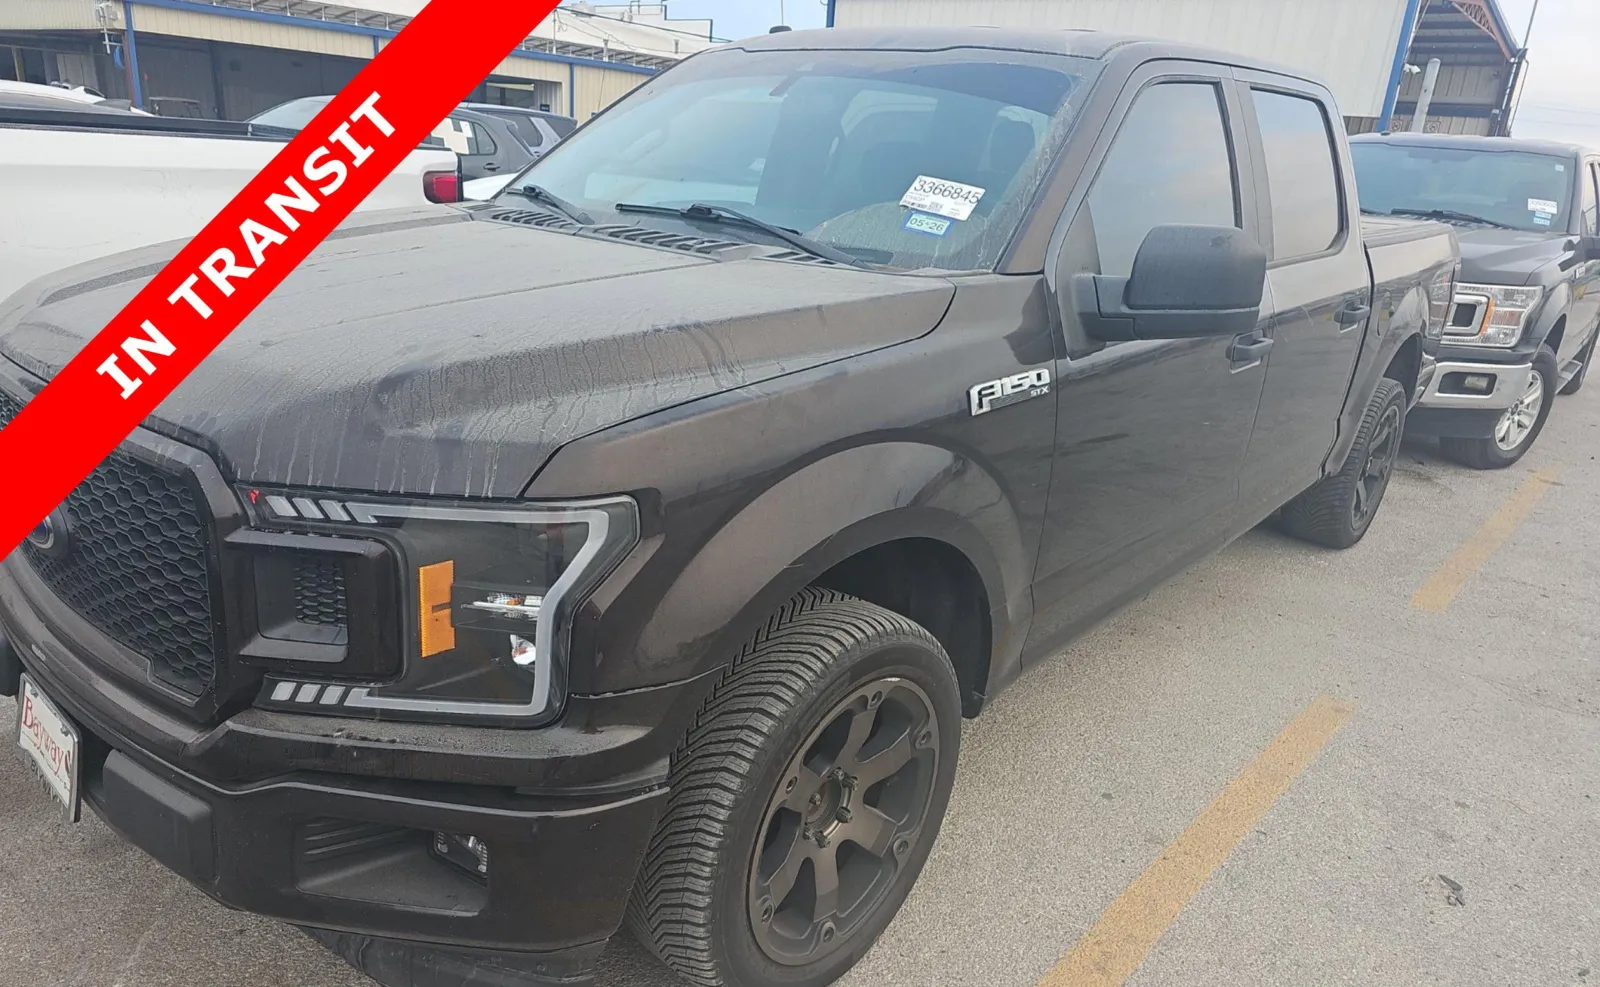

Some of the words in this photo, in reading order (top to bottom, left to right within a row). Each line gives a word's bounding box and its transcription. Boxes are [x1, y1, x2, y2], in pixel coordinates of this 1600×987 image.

[914, 180, 981, 204] 3366845
[1030, 386, 1049, 397] STX
[22, 695, 64, 776] Bayway
